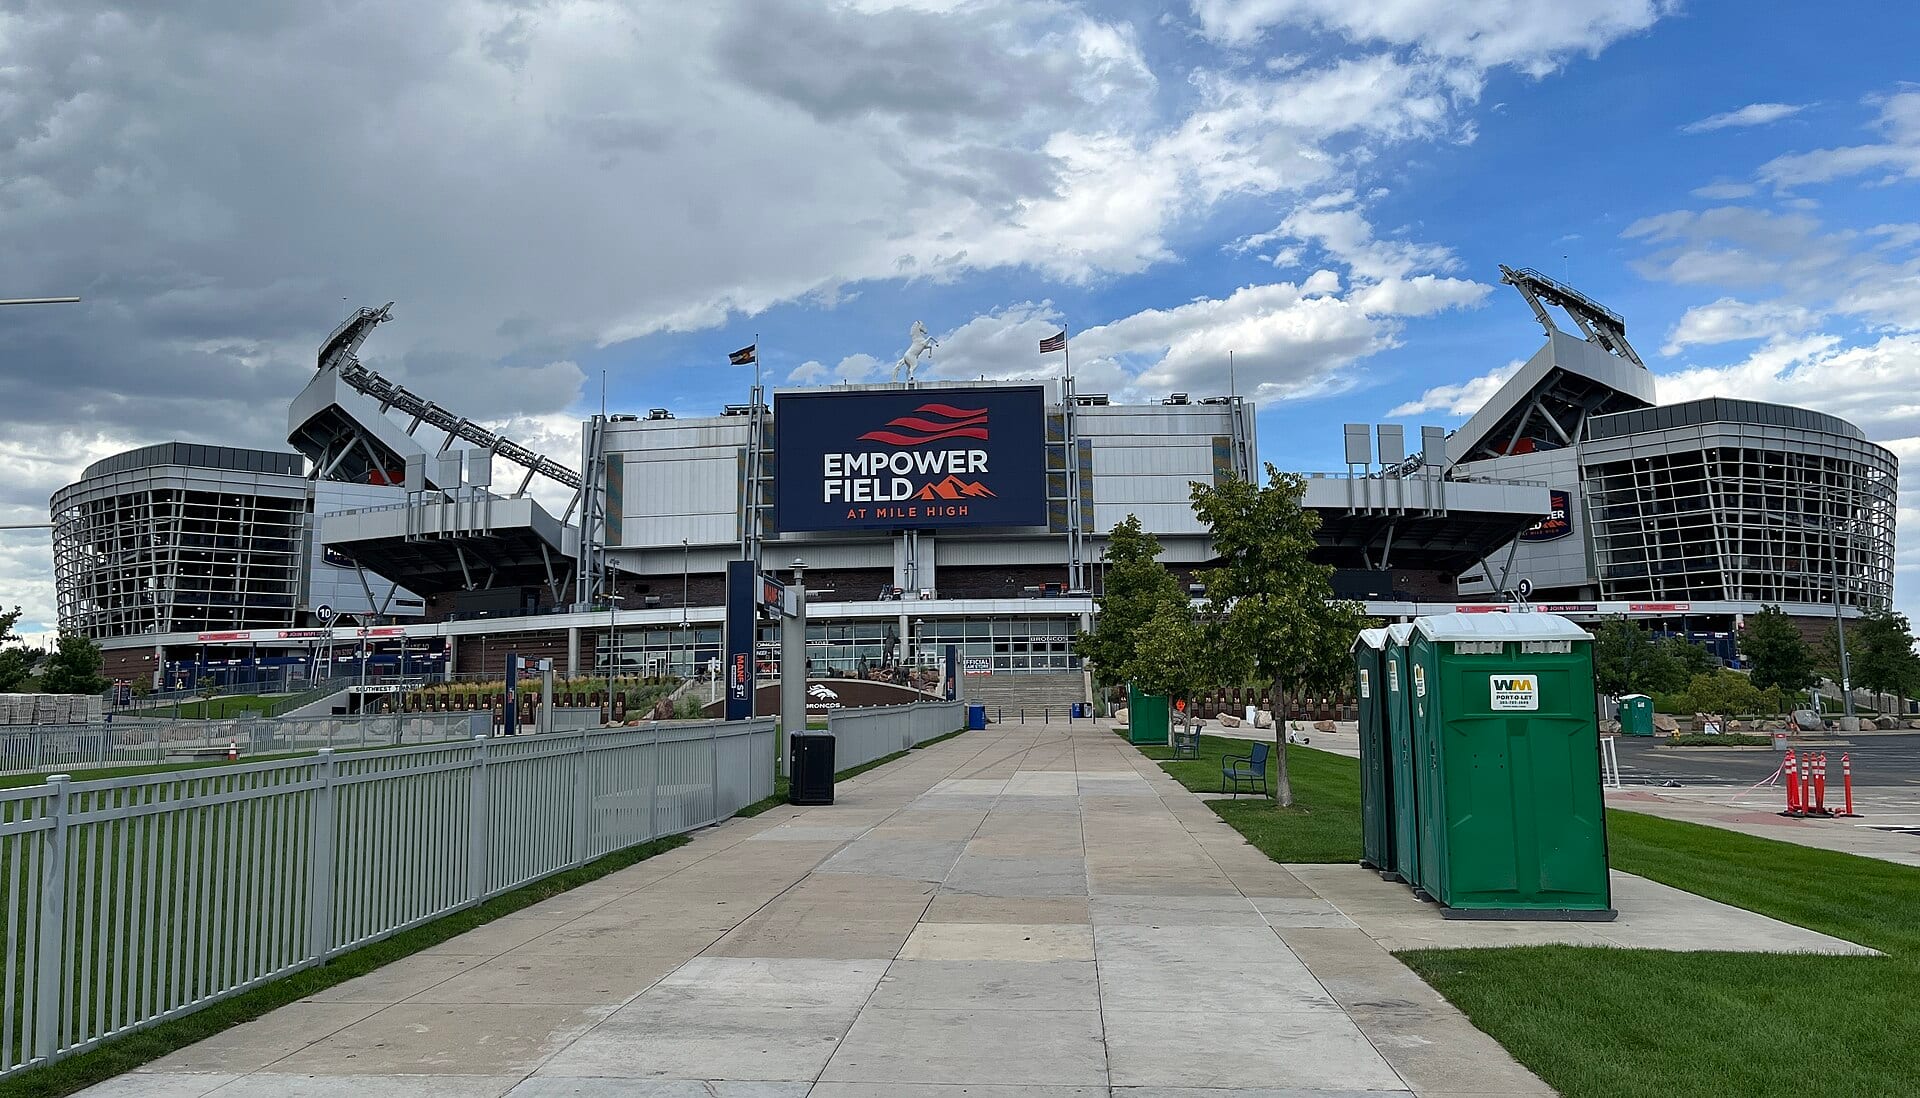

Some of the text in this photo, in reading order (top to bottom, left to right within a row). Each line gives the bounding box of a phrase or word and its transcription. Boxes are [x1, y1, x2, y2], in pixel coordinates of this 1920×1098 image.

[824, 450, 988, 477] EMPOWER
[824, 477, 913, 503] FIELD
[847, 505, 969, 519] AT MILE HIGH
[1520, 582, 1527, 593] 9
[319, 608, 331, 618] 10
[1493, 679, 1533, 691] WM
